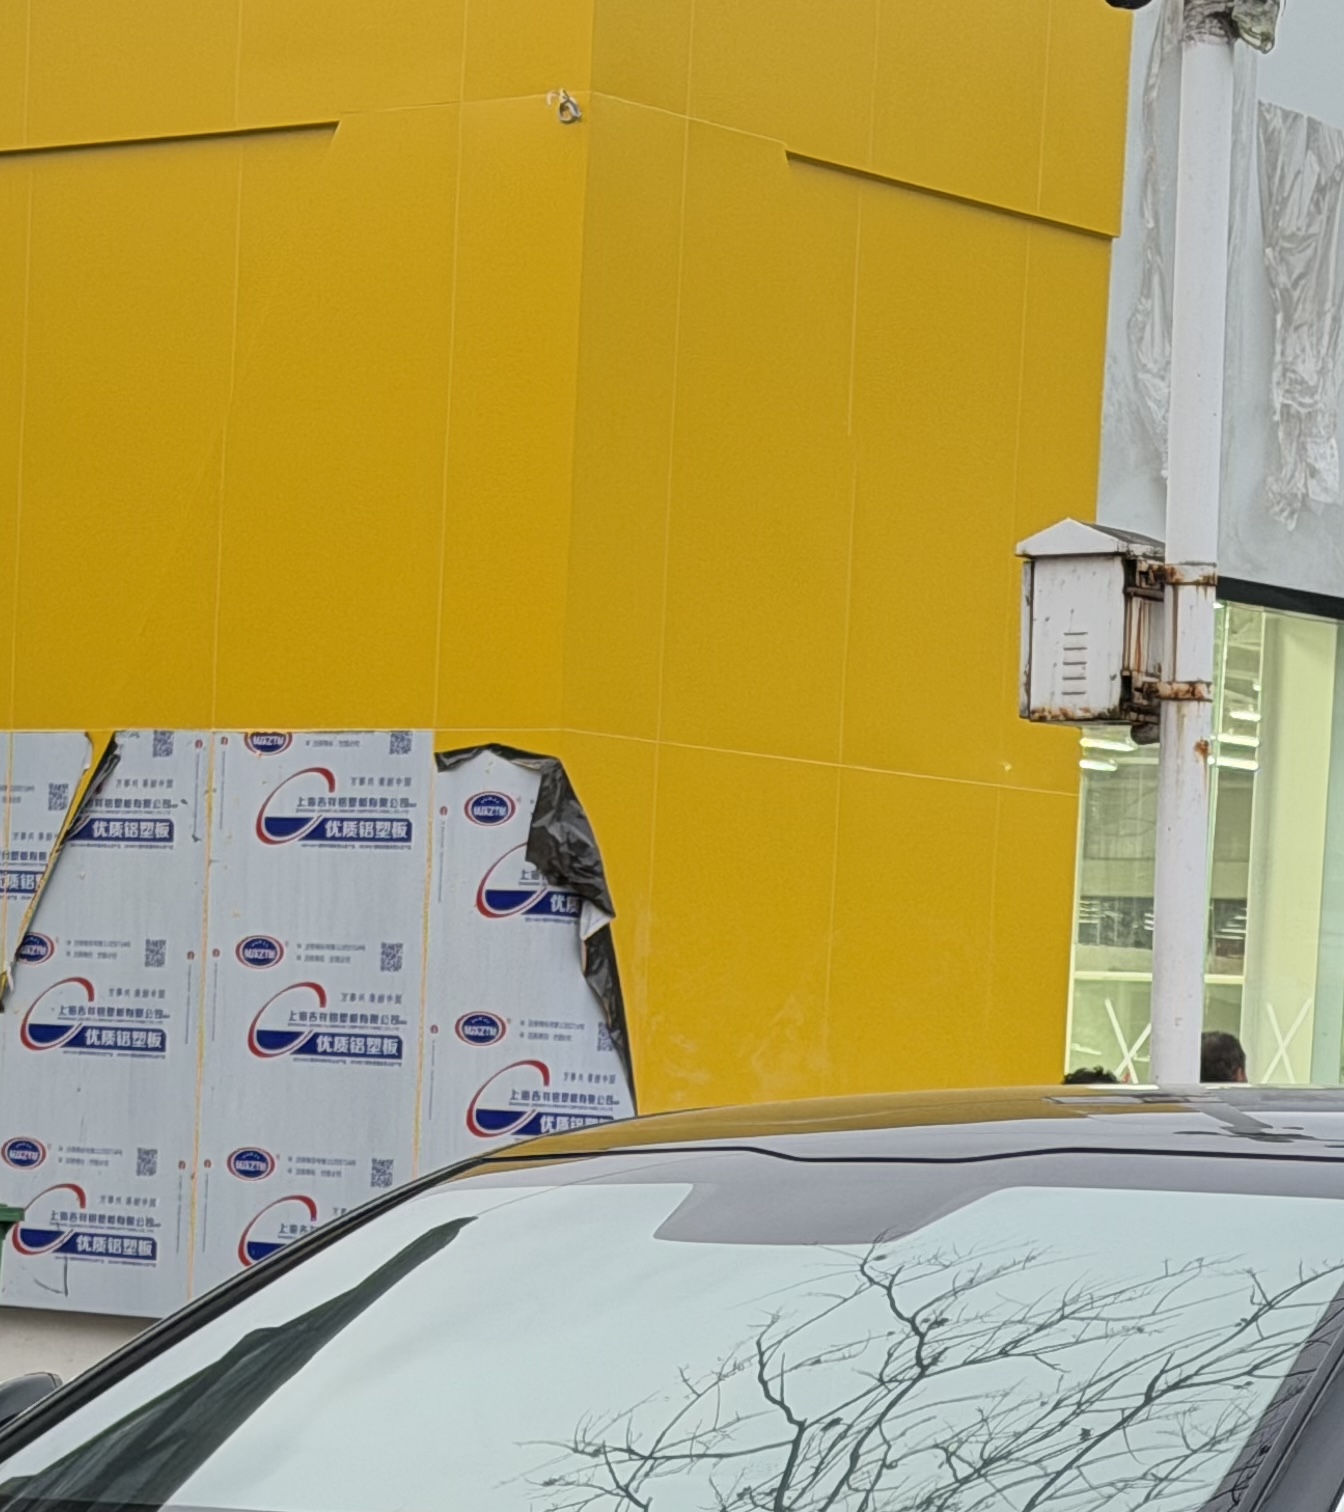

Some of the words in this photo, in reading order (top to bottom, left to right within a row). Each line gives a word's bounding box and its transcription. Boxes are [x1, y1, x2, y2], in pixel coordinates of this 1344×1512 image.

[92, 821, 170, 839] 优质铝塑板
[325, 820, 408, 839] 优质铝塑板
[85, 1028, 162, 1048] 优质铝塑板
[316, 1034, 399, 1056] 优质铝塑板
[76, 1234, 153, 1256] 优质铝塑板
